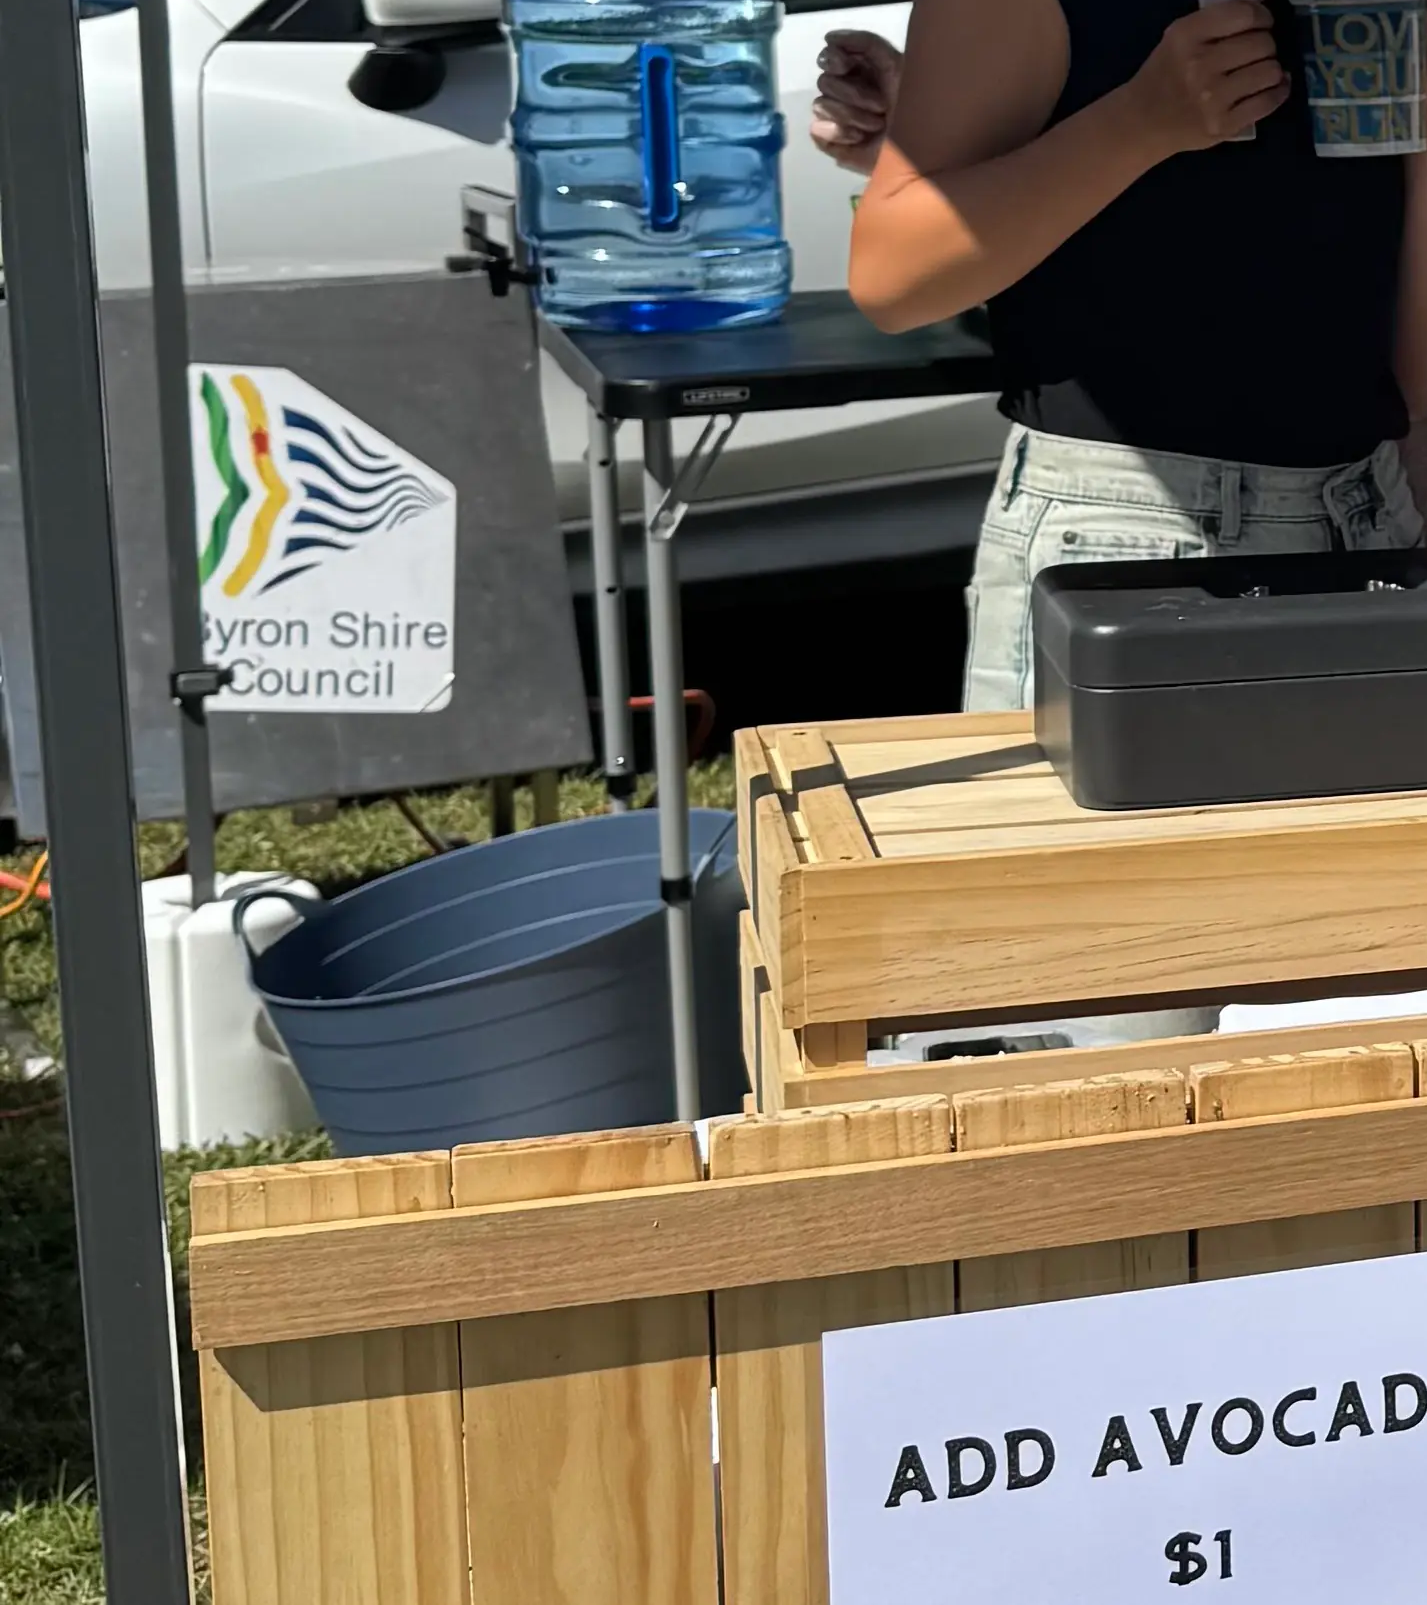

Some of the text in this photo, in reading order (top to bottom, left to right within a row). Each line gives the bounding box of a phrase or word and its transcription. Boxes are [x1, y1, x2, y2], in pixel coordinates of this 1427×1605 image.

[329, 611, 448, 649] Shire
[228, 658, 394, 697] Council
[884, 1428, 1056, 1508] ADD
[1164, 1530, 1233, 1586] $1
